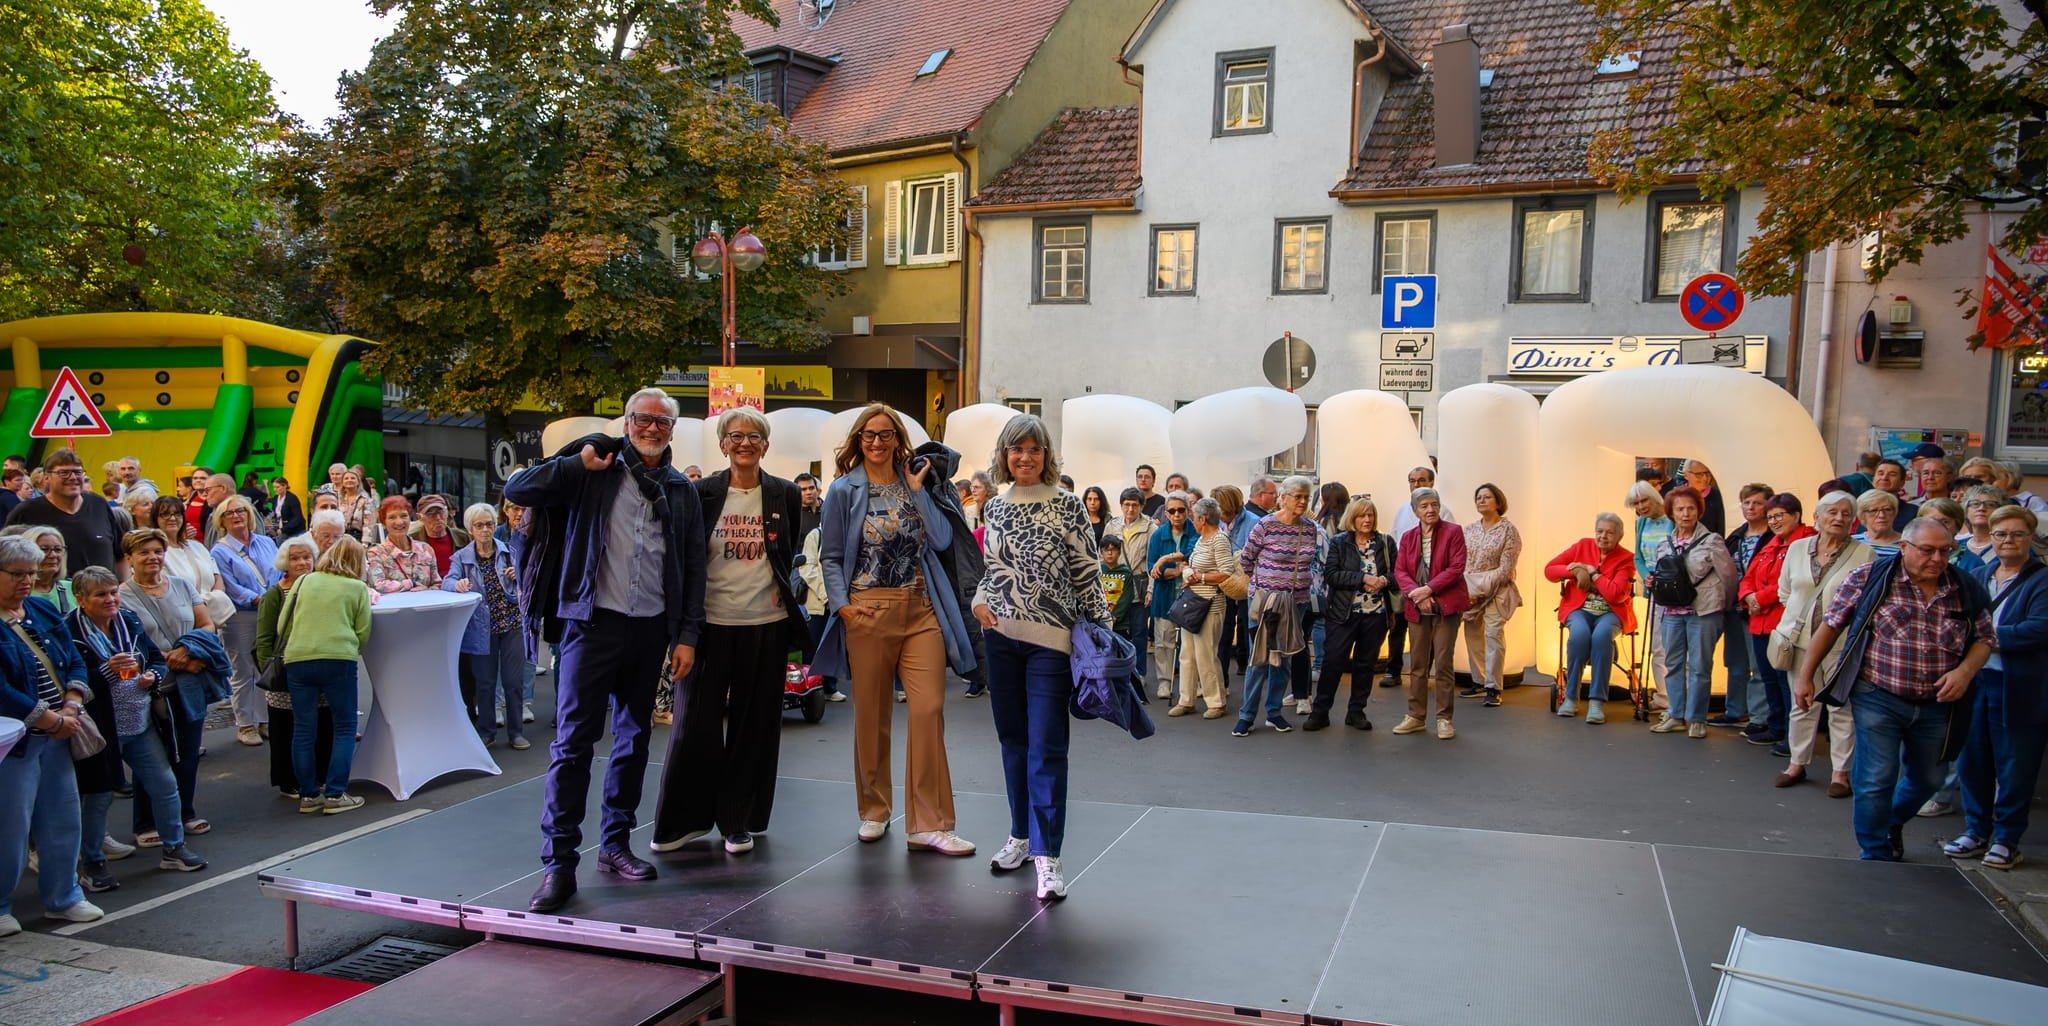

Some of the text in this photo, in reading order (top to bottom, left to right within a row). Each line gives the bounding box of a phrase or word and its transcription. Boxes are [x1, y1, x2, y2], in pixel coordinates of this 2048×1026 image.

[1394, 283, 1423, 322] P
[1512, 348, 1616, 369] Dimi's
[1385, 367, 1428, 377] während des
[1383, 379, 1429, 389] Ladevorgangs
[723, 514, 742, 525] YOU
[715, 528, 764, 538] MY HEART
